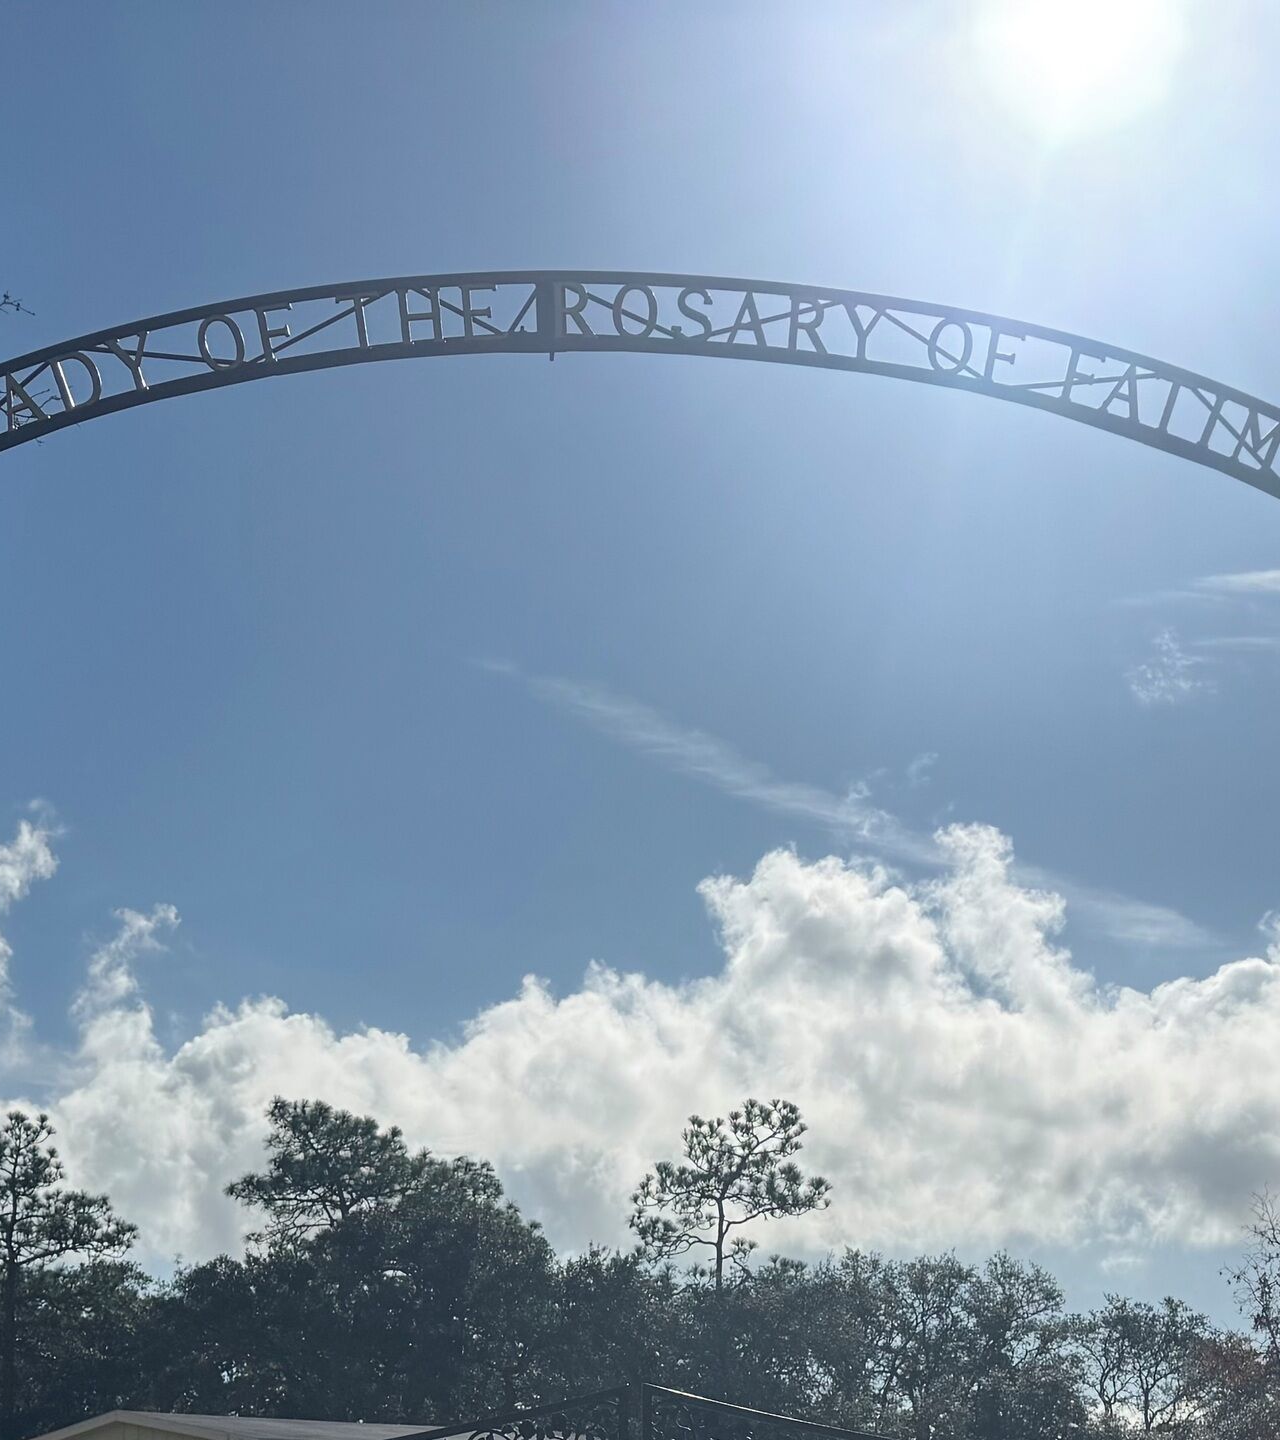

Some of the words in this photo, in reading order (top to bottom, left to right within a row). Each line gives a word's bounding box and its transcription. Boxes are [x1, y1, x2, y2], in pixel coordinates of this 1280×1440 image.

[197, 301, 294, 371] OF
[334, 283, 525, 350] THE
[553, 281, 886, 362] ROSARY
[927, 316, 1026, 382] OF
